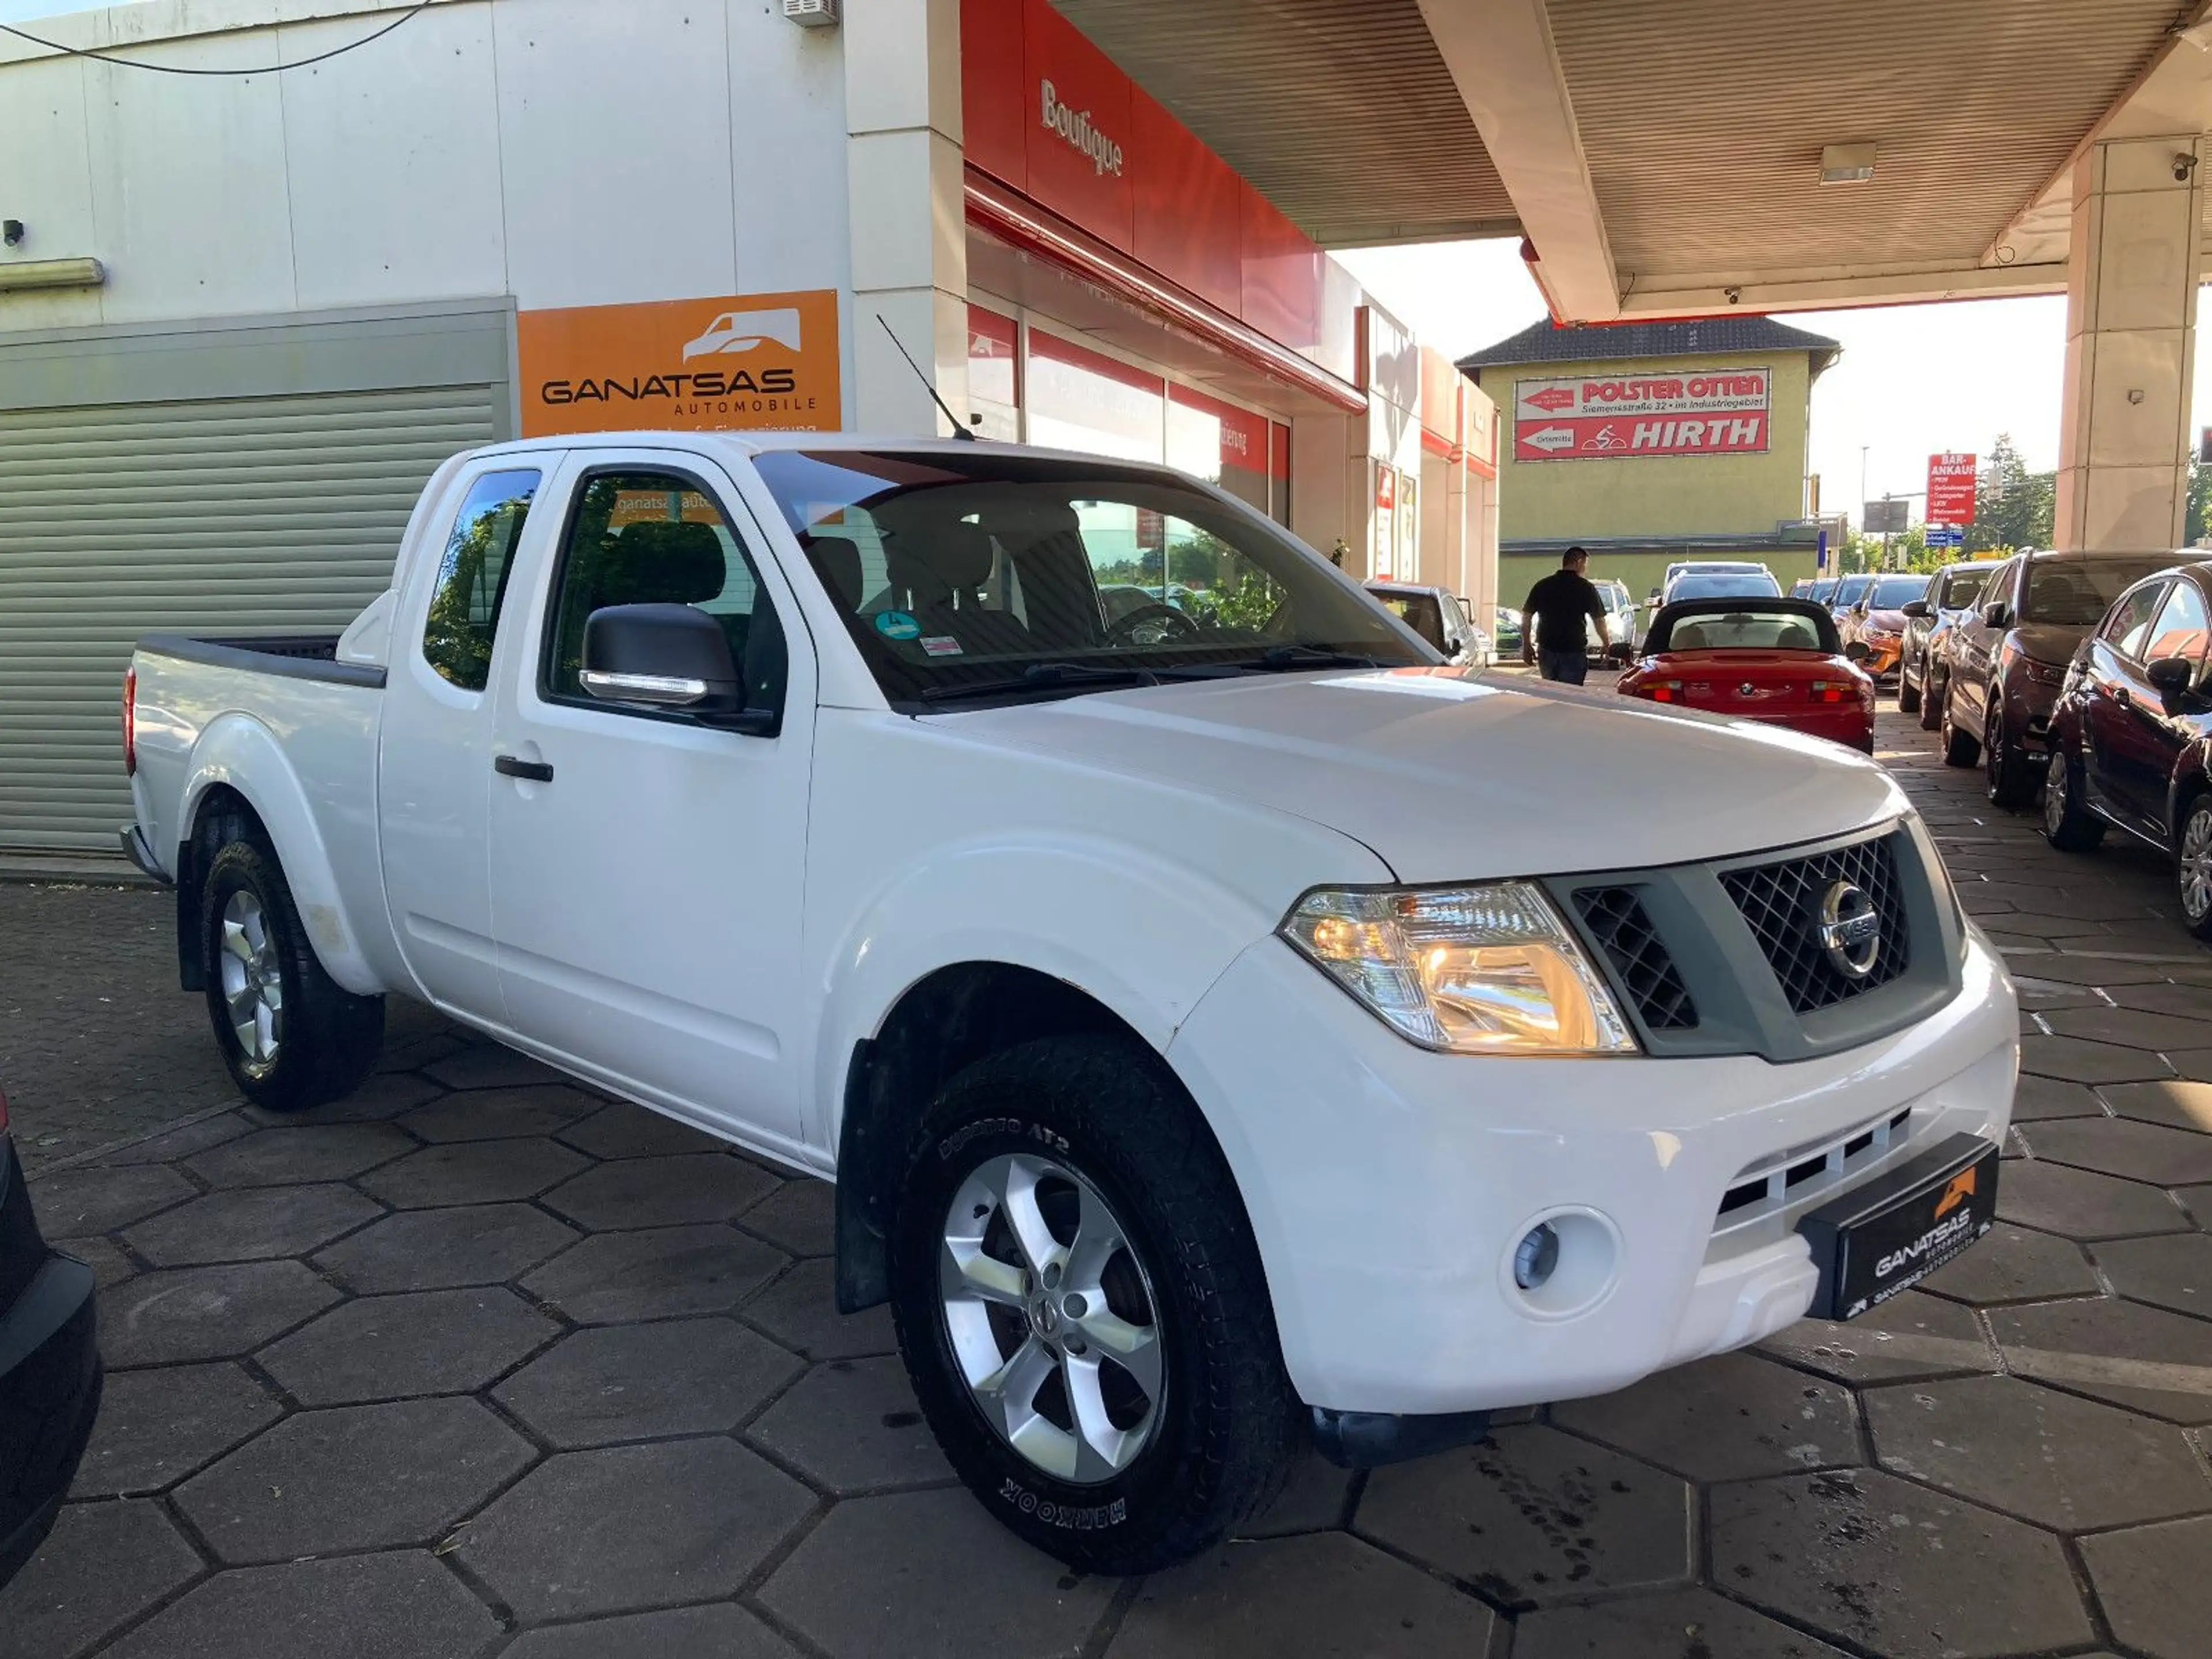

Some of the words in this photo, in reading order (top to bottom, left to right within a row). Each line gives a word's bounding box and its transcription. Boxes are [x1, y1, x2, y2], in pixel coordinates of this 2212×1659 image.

[1040, 78, 1123, 177] Boutique
[541, 368, 796, 404] GANATSAS
[1581, 378, 1683, 403] POLSTER
[674, 397, 817, 416] AUTOMOBILE
[1631, 418, 1761, 449] HIRTH
[1931, 465, 1975, 475] ANKAUF
[1875, 1207, 1971, 1278] GANATSAS
